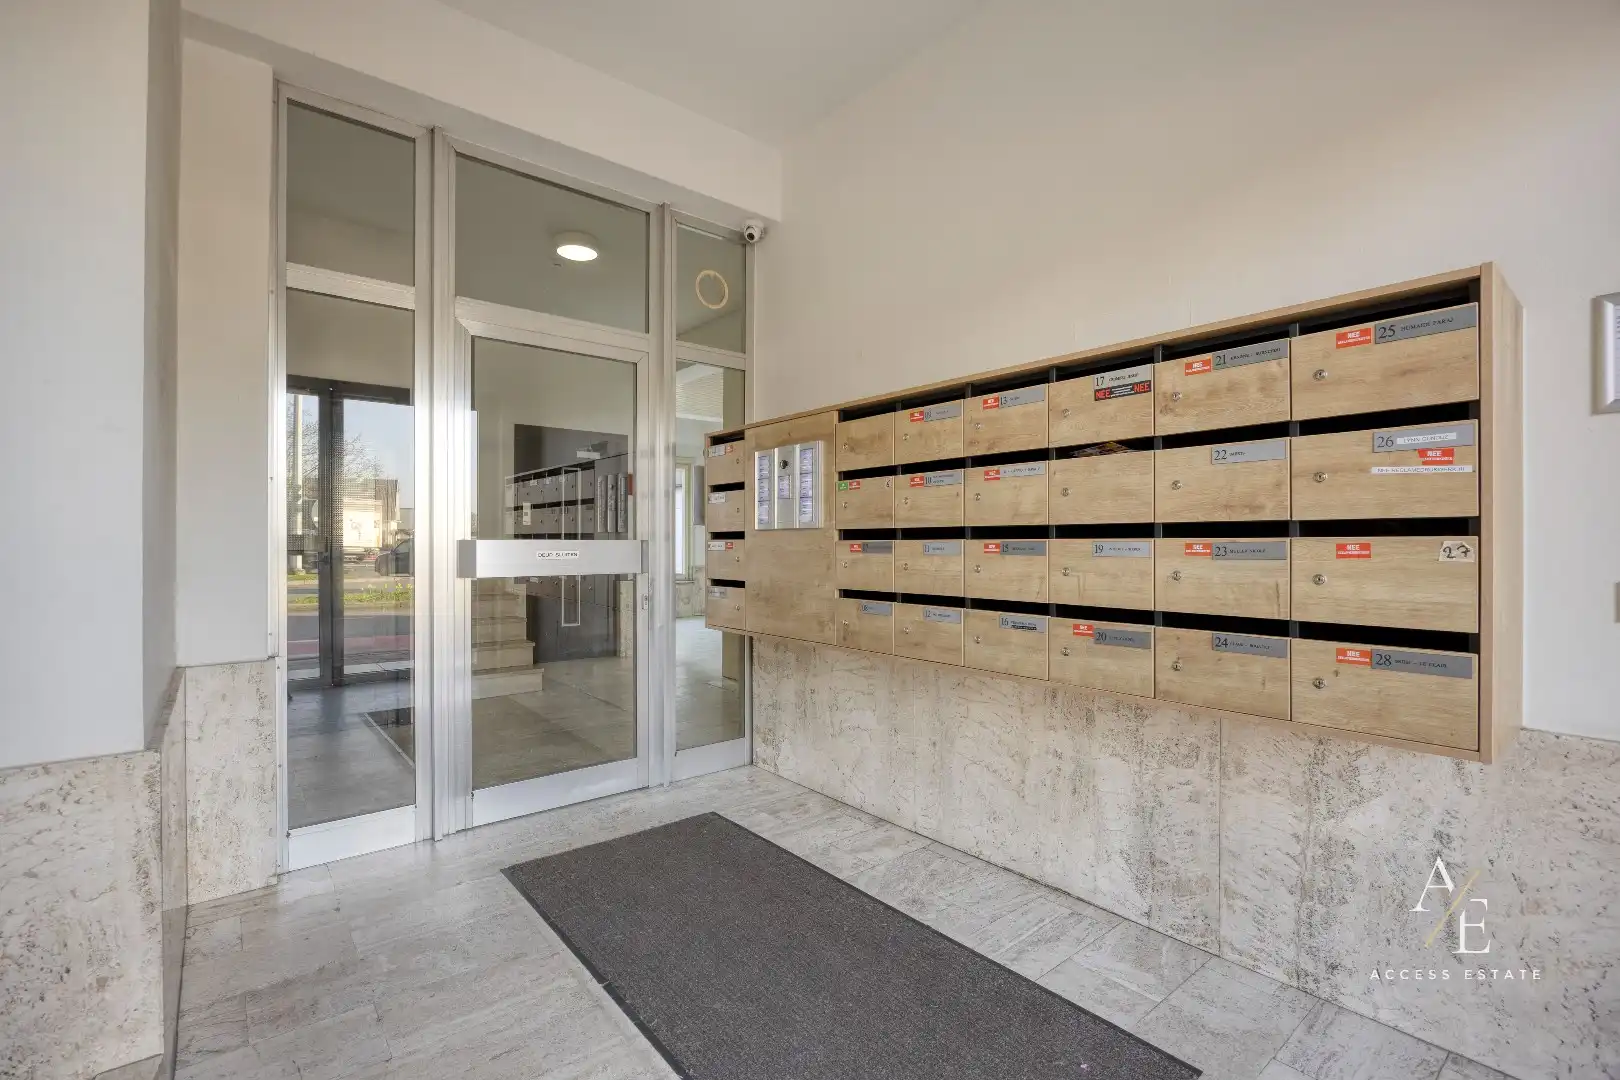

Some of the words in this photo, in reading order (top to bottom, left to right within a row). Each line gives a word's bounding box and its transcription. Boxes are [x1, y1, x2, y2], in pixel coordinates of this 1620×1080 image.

[1378, 324, 1396, 339] 25
[1215, 354, 1227, 366] 21
[1095, 376, 1105, 386] 17
[1134, 382, 1149, 392] NEE
[1096, 388, 1111, 399] NEE
[1376, 435, 1394, 448] 26
[1214, 449, 1227, 460] 22
[1094, 544, 1104, 553] 19
[1214, 546, 1227, 557] 23
[1095, 631, 1107, 642] 20
[1215, 636, 1228, 648] 24
[1375, 653, 1392, 667] 28
